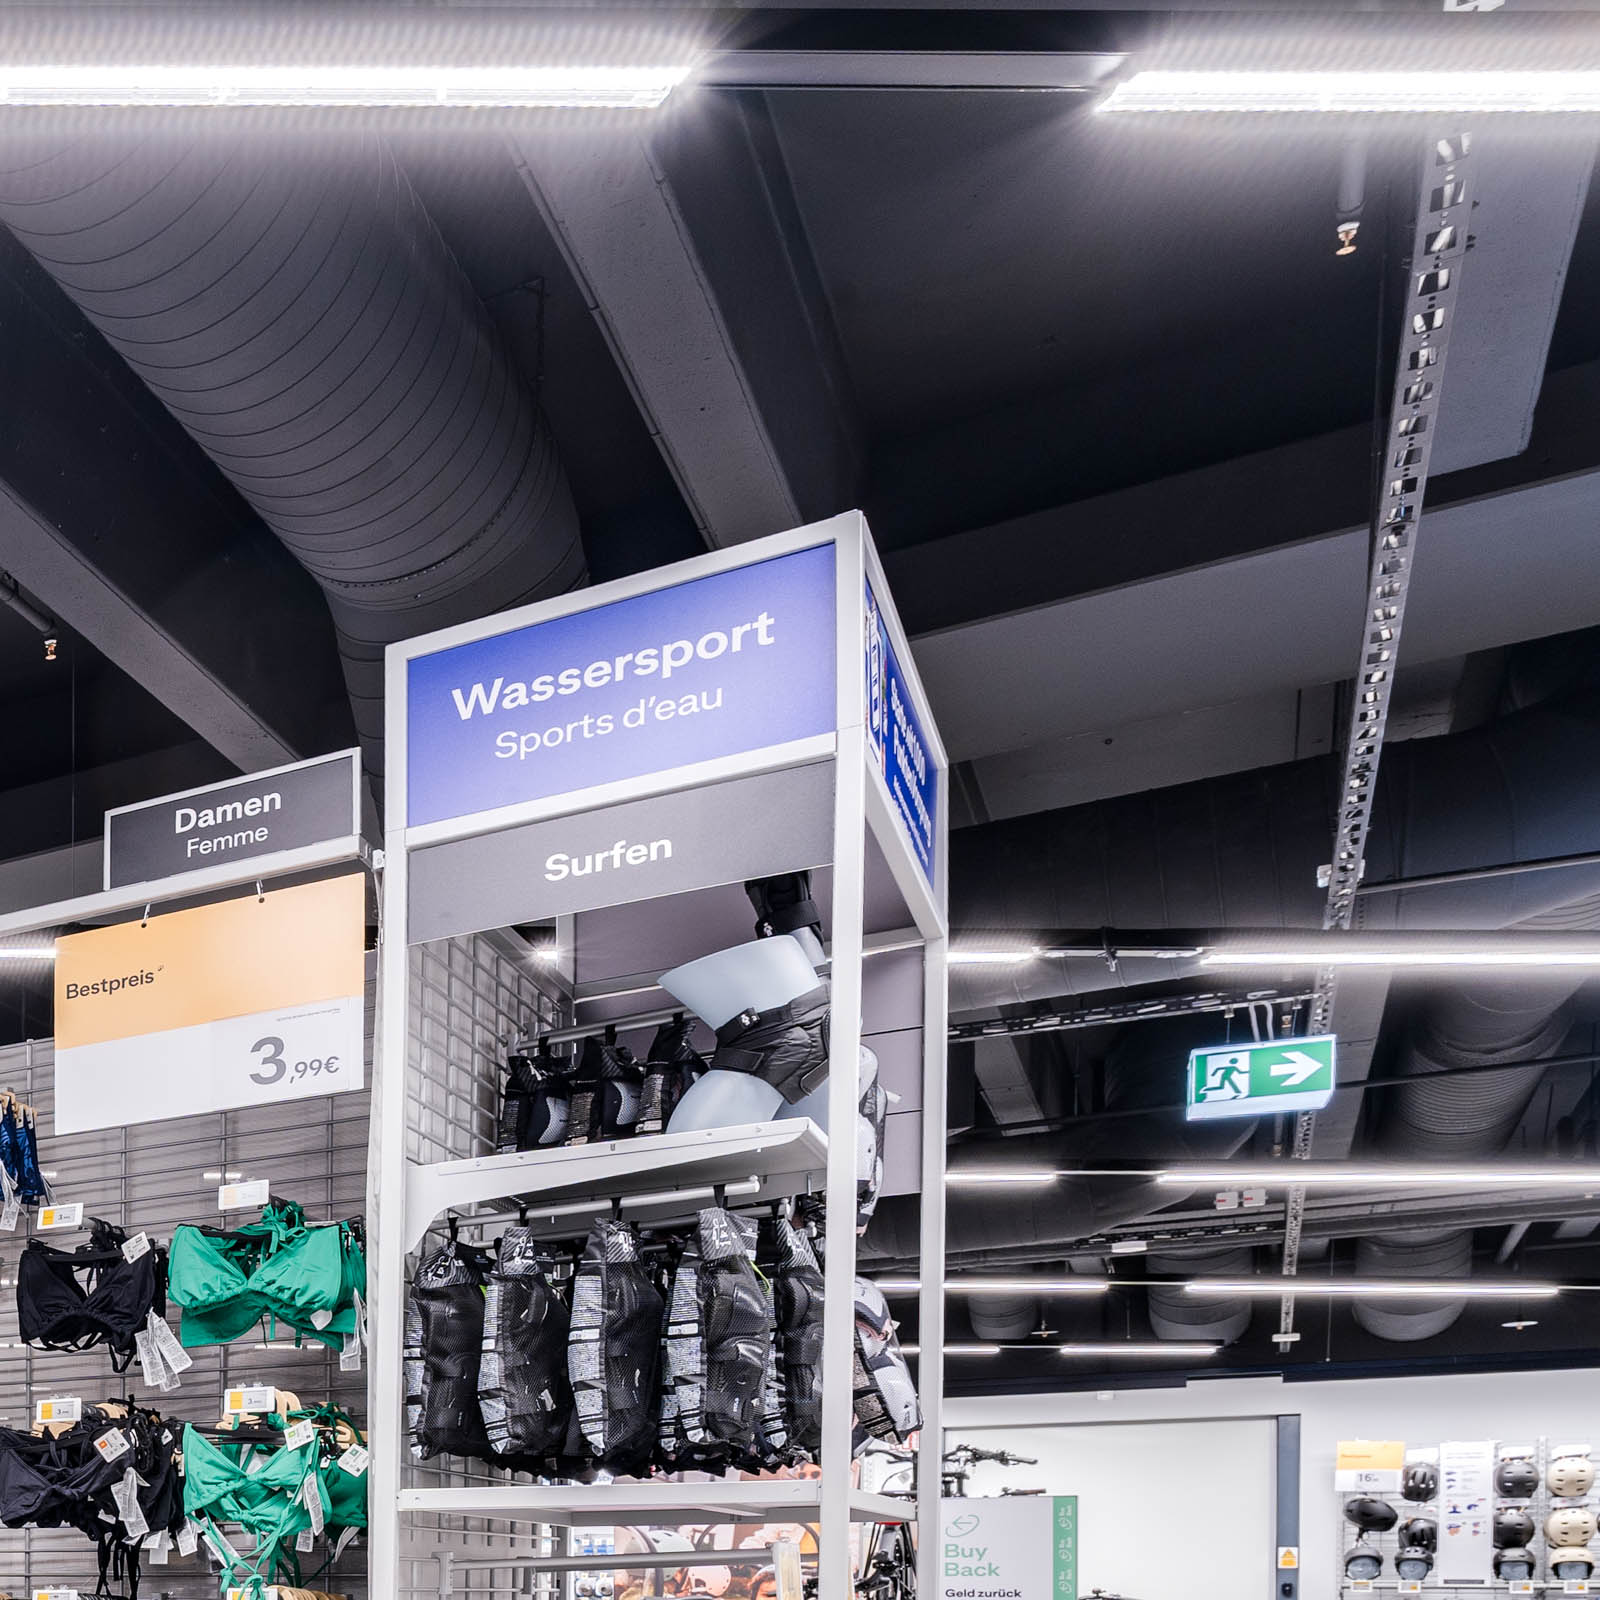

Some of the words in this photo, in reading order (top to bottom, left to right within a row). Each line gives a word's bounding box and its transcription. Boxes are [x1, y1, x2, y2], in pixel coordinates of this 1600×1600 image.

[451, 611, 775, 721] Wassersport
[494, 712, 615, 760] Sports
[623, 687, 724, 728] d'eau
[175, 791, 282, 834] Damen
[186, 825, 269, 858] Femme
[543, 836, 672, 882] Surfen
[65, 969, 154, 1000] Bestpreis
[249, 1036, 341, 1085] 3,99€
[944, 1543, 989, 1561] Buy
[944, 1562, 1000, 1577] Back
[945, 1588, 975, 1598] Geld
[977, 1588, 1022, 1598] zurück
